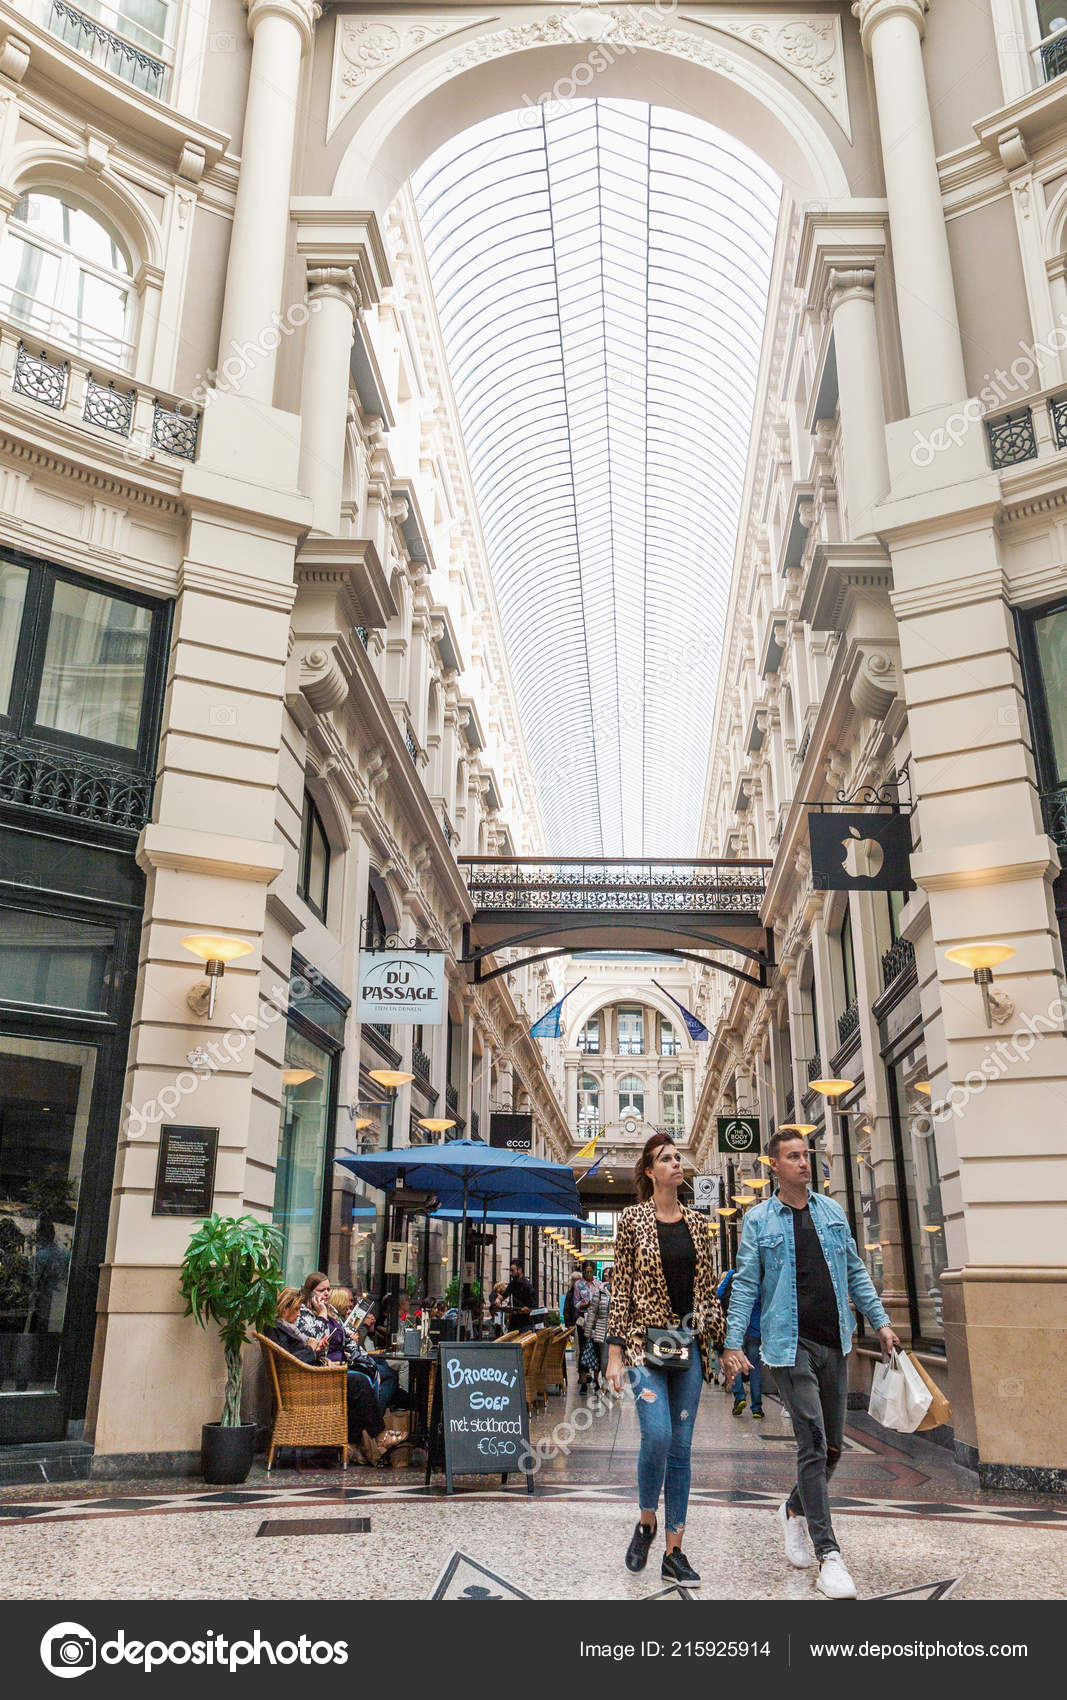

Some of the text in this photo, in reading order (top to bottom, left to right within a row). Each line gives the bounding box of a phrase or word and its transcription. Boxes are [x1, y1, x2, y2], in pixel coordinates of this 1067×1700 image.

[386, 971, 410, 985] DU
[362, 986, 439, 1001] PASSAGE
[506, 1140, 530, 1148] ecco
[469, 1391, 510, 1411] SOEP
[450, 1416, 469, 1432] met
[476, 1436, 517, 1457] €6,50
